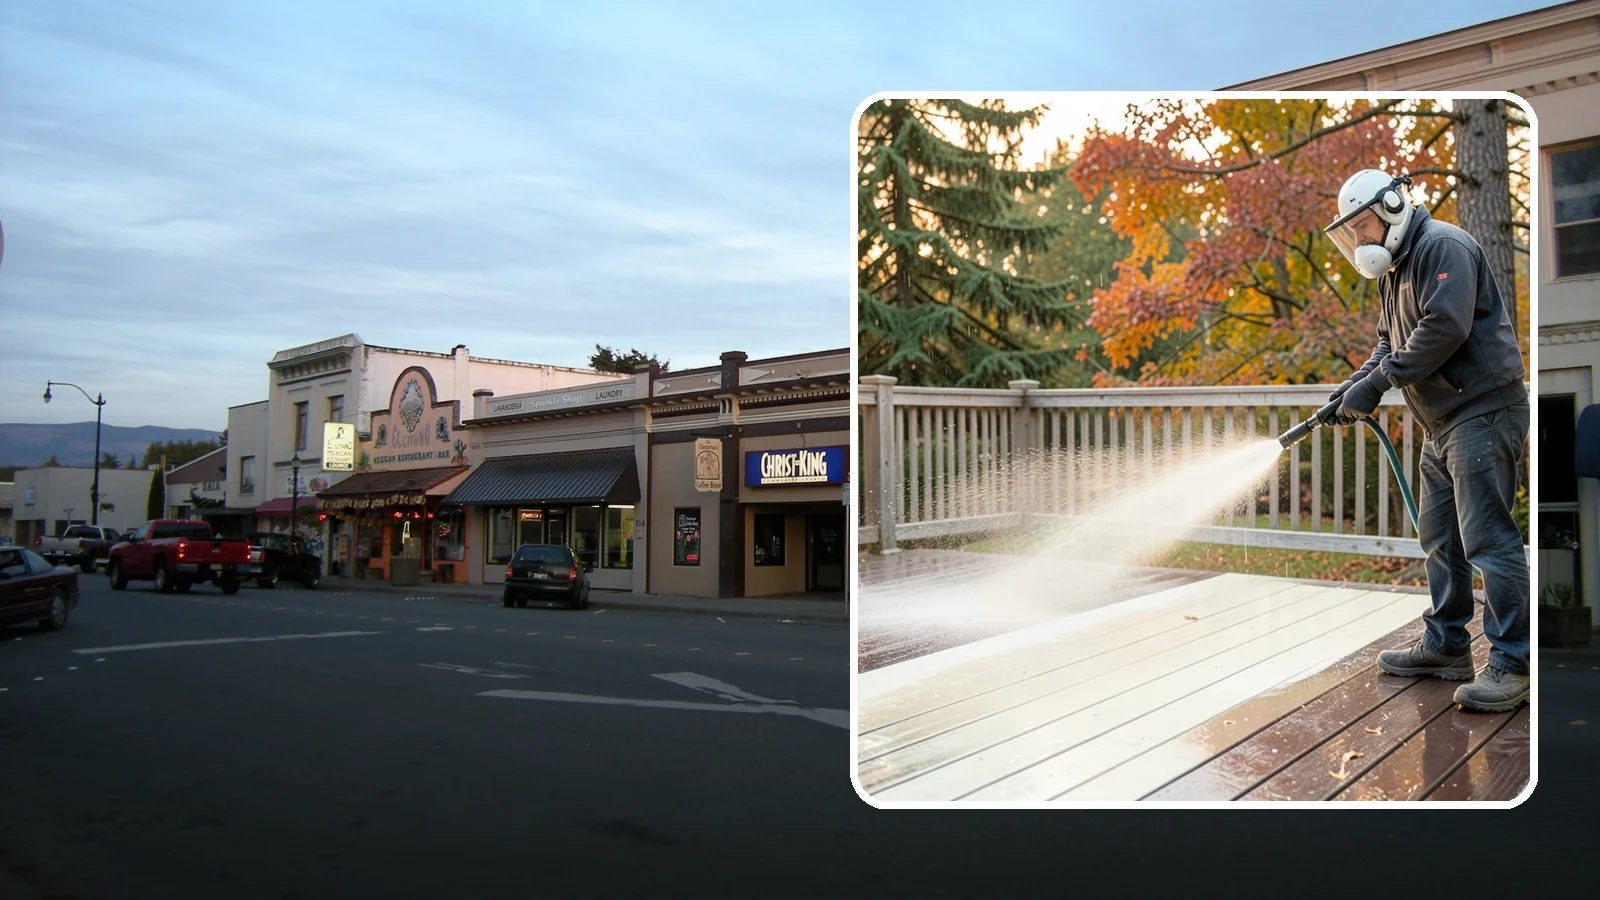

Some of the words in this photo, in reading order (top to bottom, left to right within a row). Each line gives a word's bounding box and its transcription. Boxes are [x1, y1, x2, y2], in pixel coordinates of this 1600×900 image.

[493, 402, 523, 413] LAVANDERIA
[562, 394, 583, 405] Shop
[595, 389, 624, 400] LAUNDRY
[397, 451, 433, 462] RESTAURANT
[438, 450, 450, 459] BAR
[799, 450, 827, 477] KING
